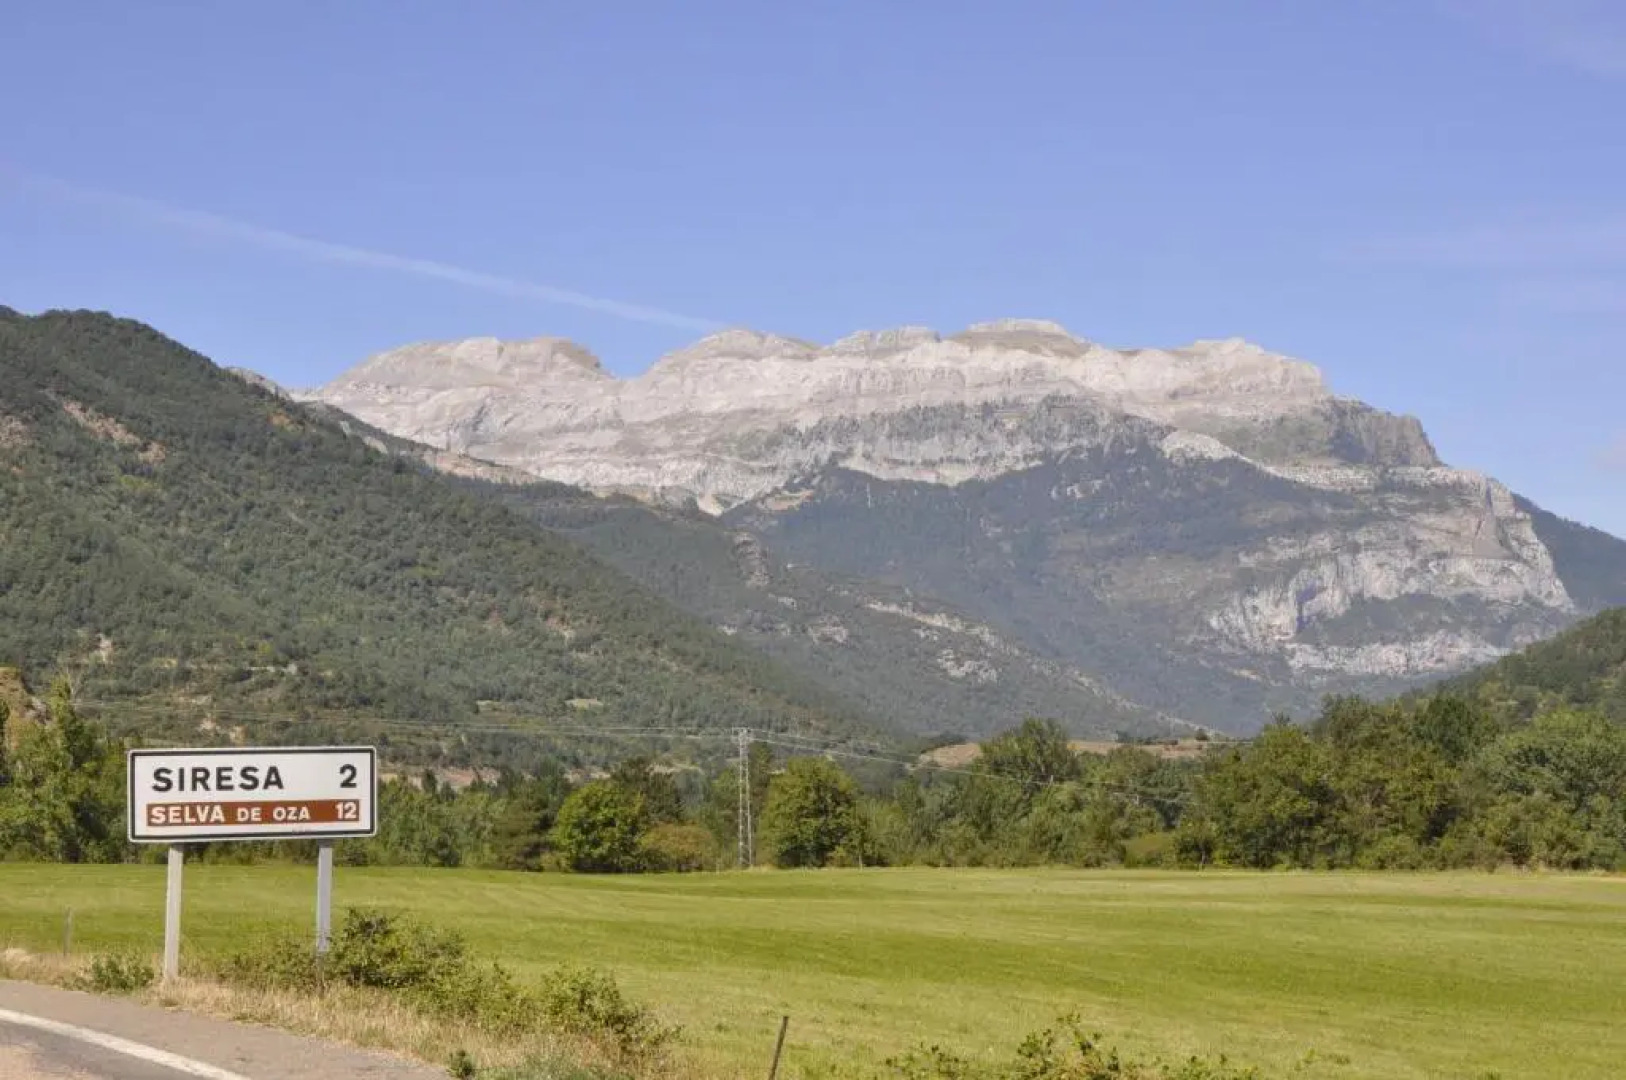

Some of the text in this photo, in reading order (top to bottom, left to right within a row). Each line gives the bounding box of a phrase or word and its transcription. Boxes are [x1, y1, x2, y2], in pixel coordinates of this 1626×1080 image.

[152, 764, 357, 792] SIRESA 2
[151, 802, 357, 824] SELVA DE OZA 12
